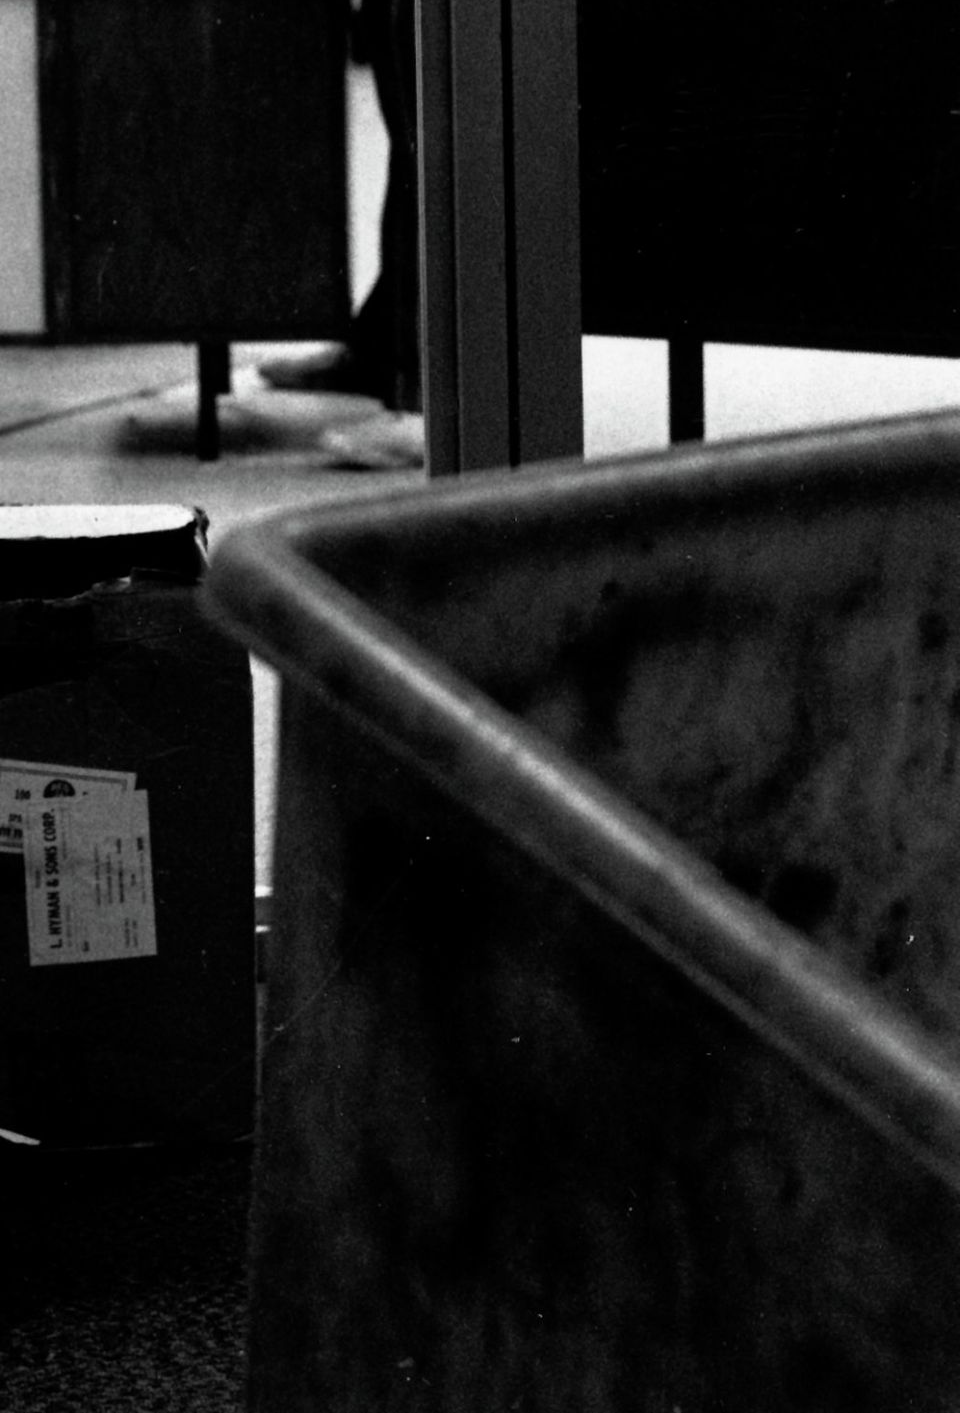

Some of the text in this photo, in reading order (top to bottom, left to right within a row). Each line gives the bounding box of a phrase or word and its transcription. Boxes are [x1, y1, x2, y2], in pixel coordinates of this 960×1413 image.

[42, 808, 57, 842] CORP.
[44, 845, 60, 875] SONS
[46, 878, 60, 887] &
[47, 890, 62, 935] HYMAN
